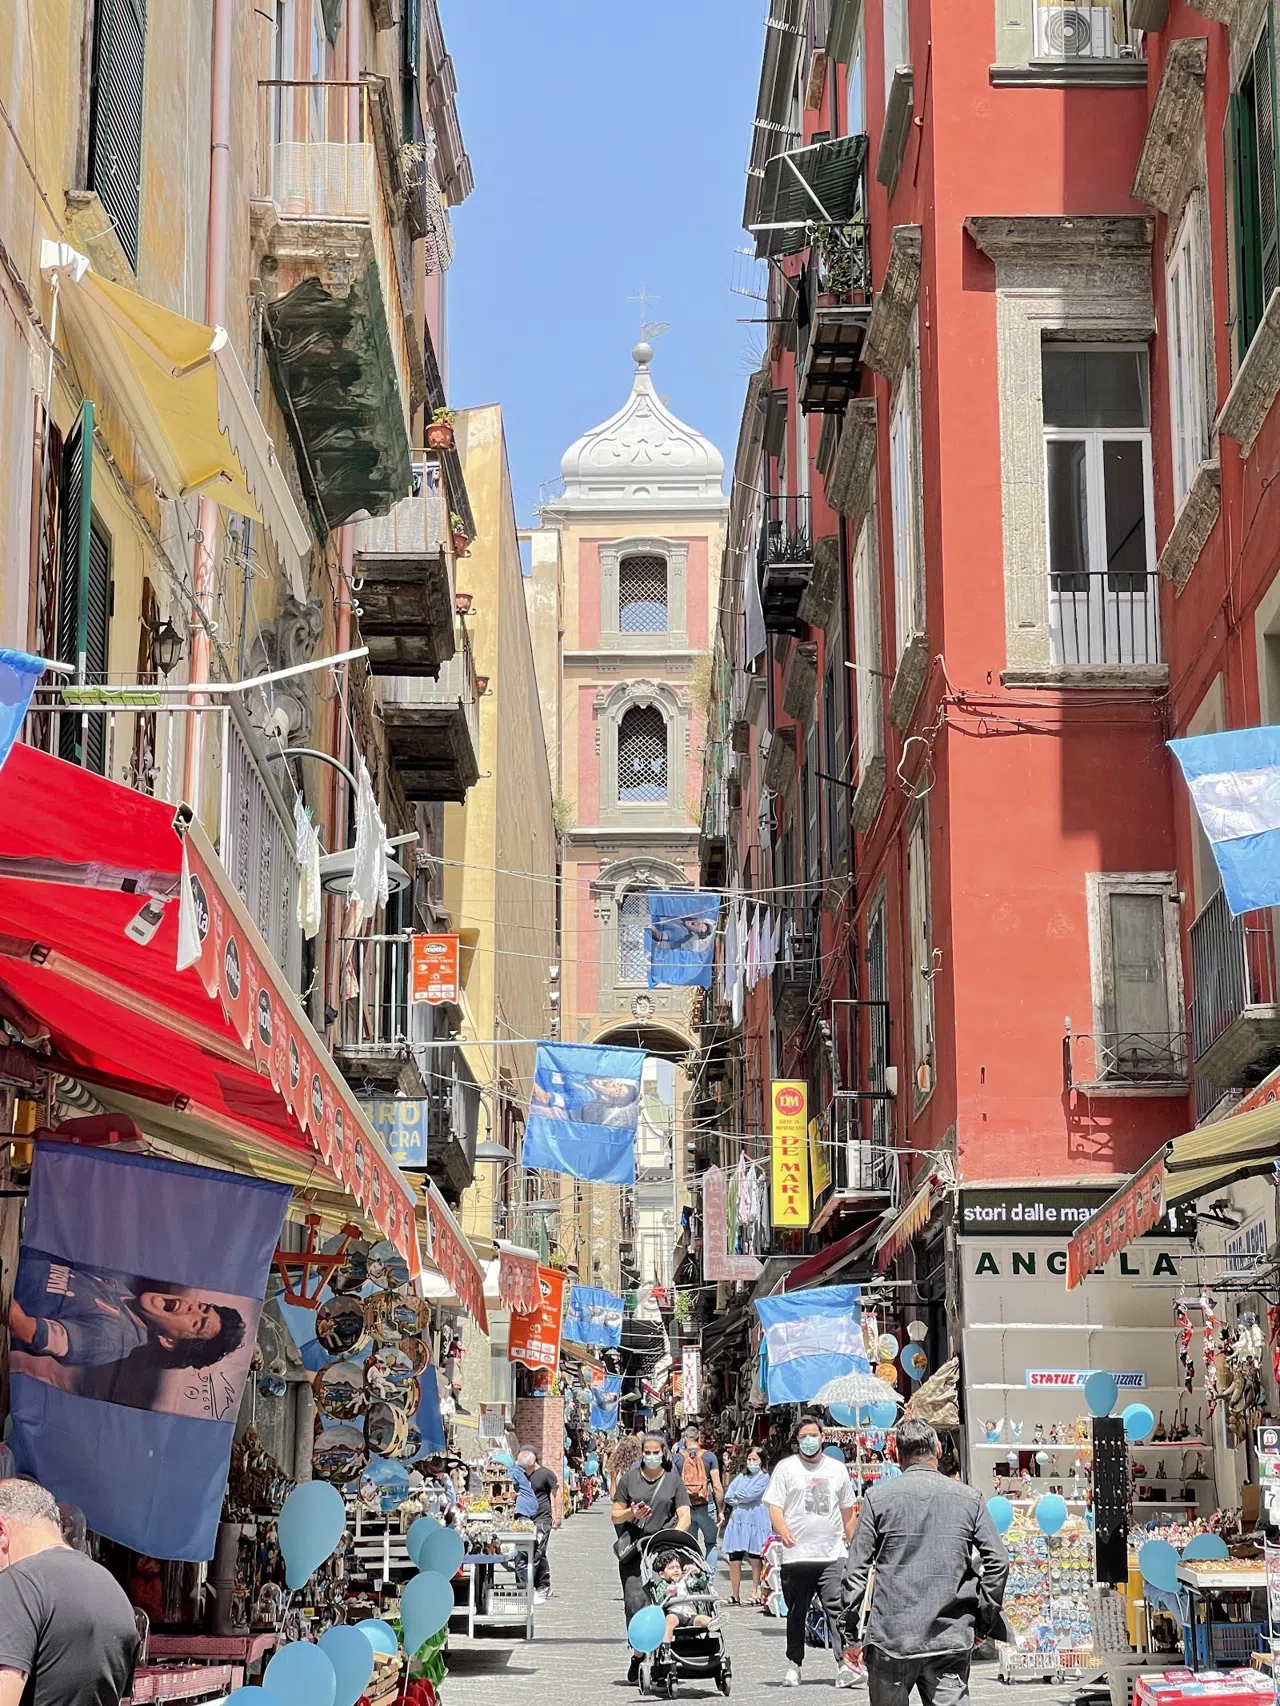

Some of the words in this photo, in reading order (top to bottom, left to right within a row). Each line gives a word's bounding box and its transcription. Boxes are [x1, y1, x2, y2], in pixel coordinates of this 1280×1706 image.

[779, 1095, 800, 1107] DM
[781, 1135, 800, 1157] DE
[780, 1162, 801, 1216] MARIA
[963, 1203, 1007, 1222] stori
[1010, 1202, 1058, 1222] dalle
[684, 1363, 696, 1413] VIRGILIO
[1030, 1373, 1076, 1385] STATUE
[197, 1372, 211, 1411] DIEGO
